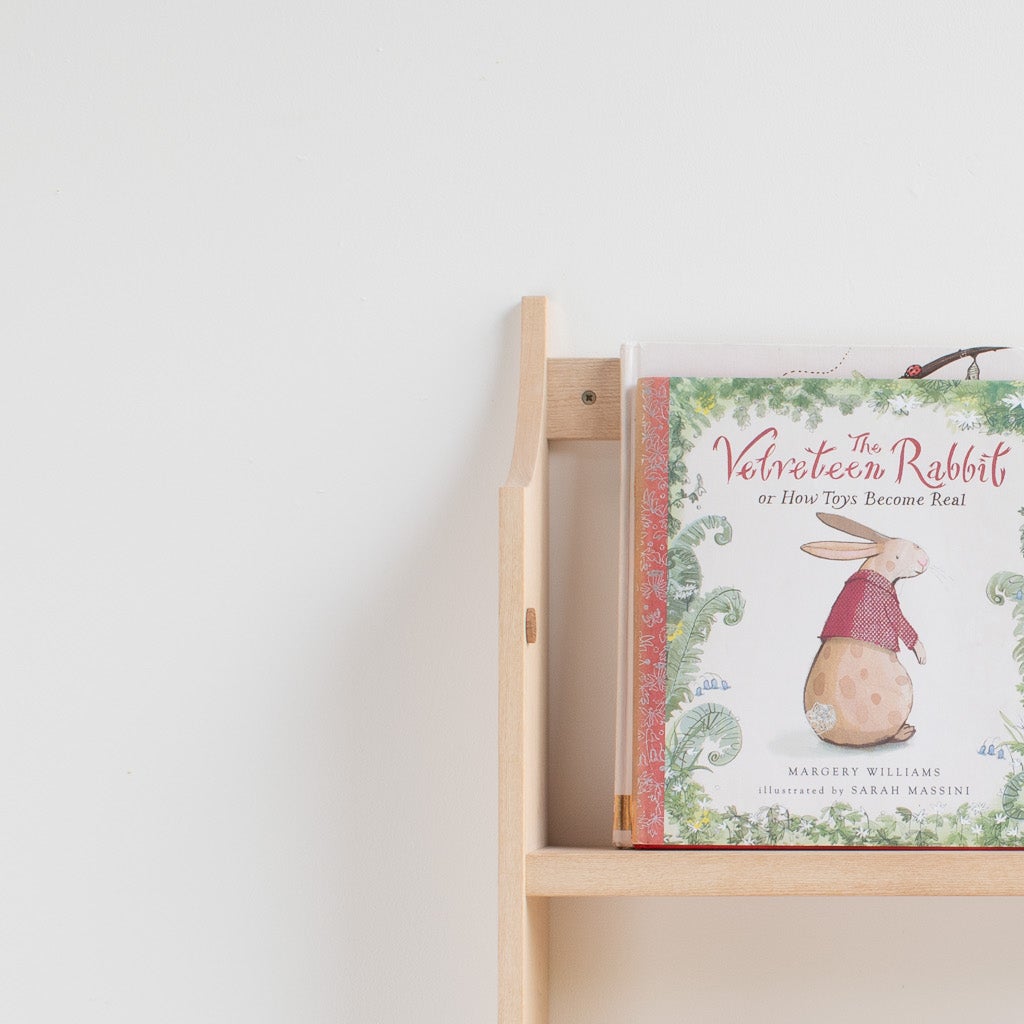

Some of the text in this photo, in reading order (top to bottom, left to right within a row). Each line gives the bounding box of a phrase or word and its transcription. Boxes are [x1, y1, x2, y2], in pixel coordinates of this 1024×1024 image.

[848, 432, 882, 455] The
[713, 427, 1012, 489] Velveteen Rabbit
[758, 490, 966, 510] or How Toys Become Real
[788, 767, 941, 777] MARGERY WILLIAMS
[758, 786, 970, 797] illustrated by SARAH MASSINI
